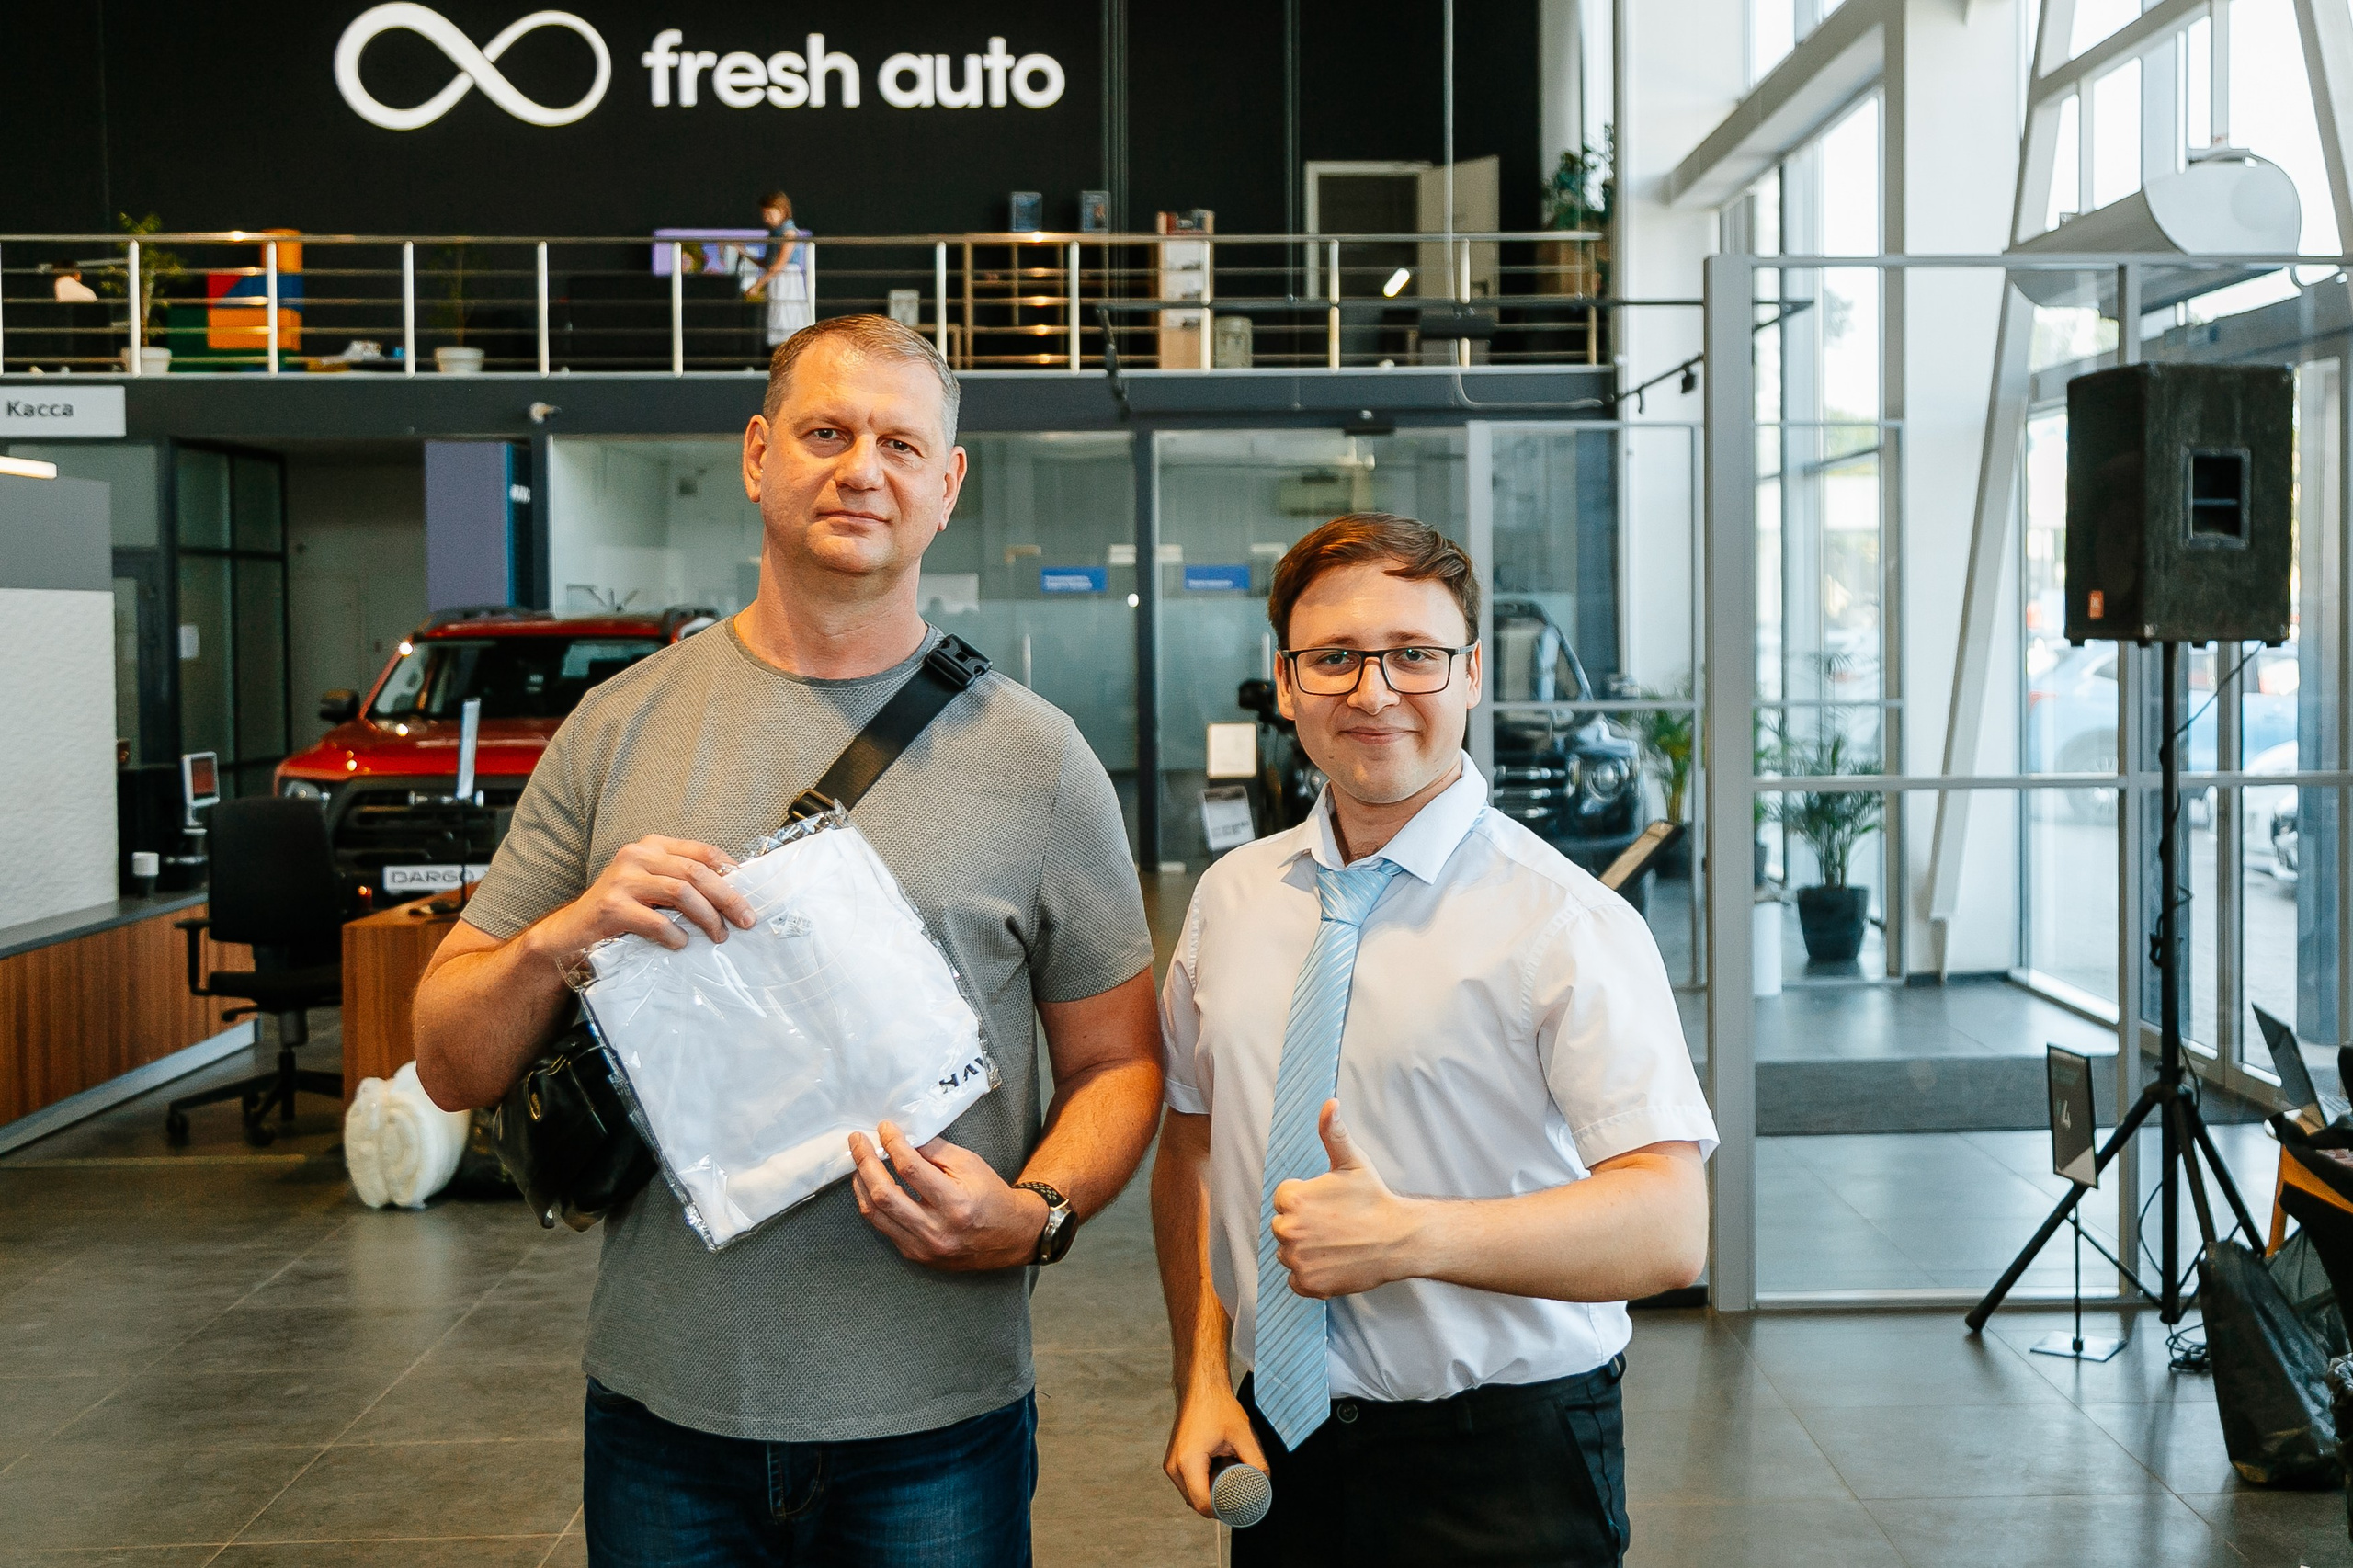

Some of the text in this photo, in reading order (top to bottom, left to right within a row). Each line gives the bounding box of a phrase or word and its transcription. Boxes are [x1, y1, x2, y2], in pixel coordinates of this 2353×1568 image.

[642, 28, 1066, 109] fresh auto
[6, 399, 74, 417] Касса
